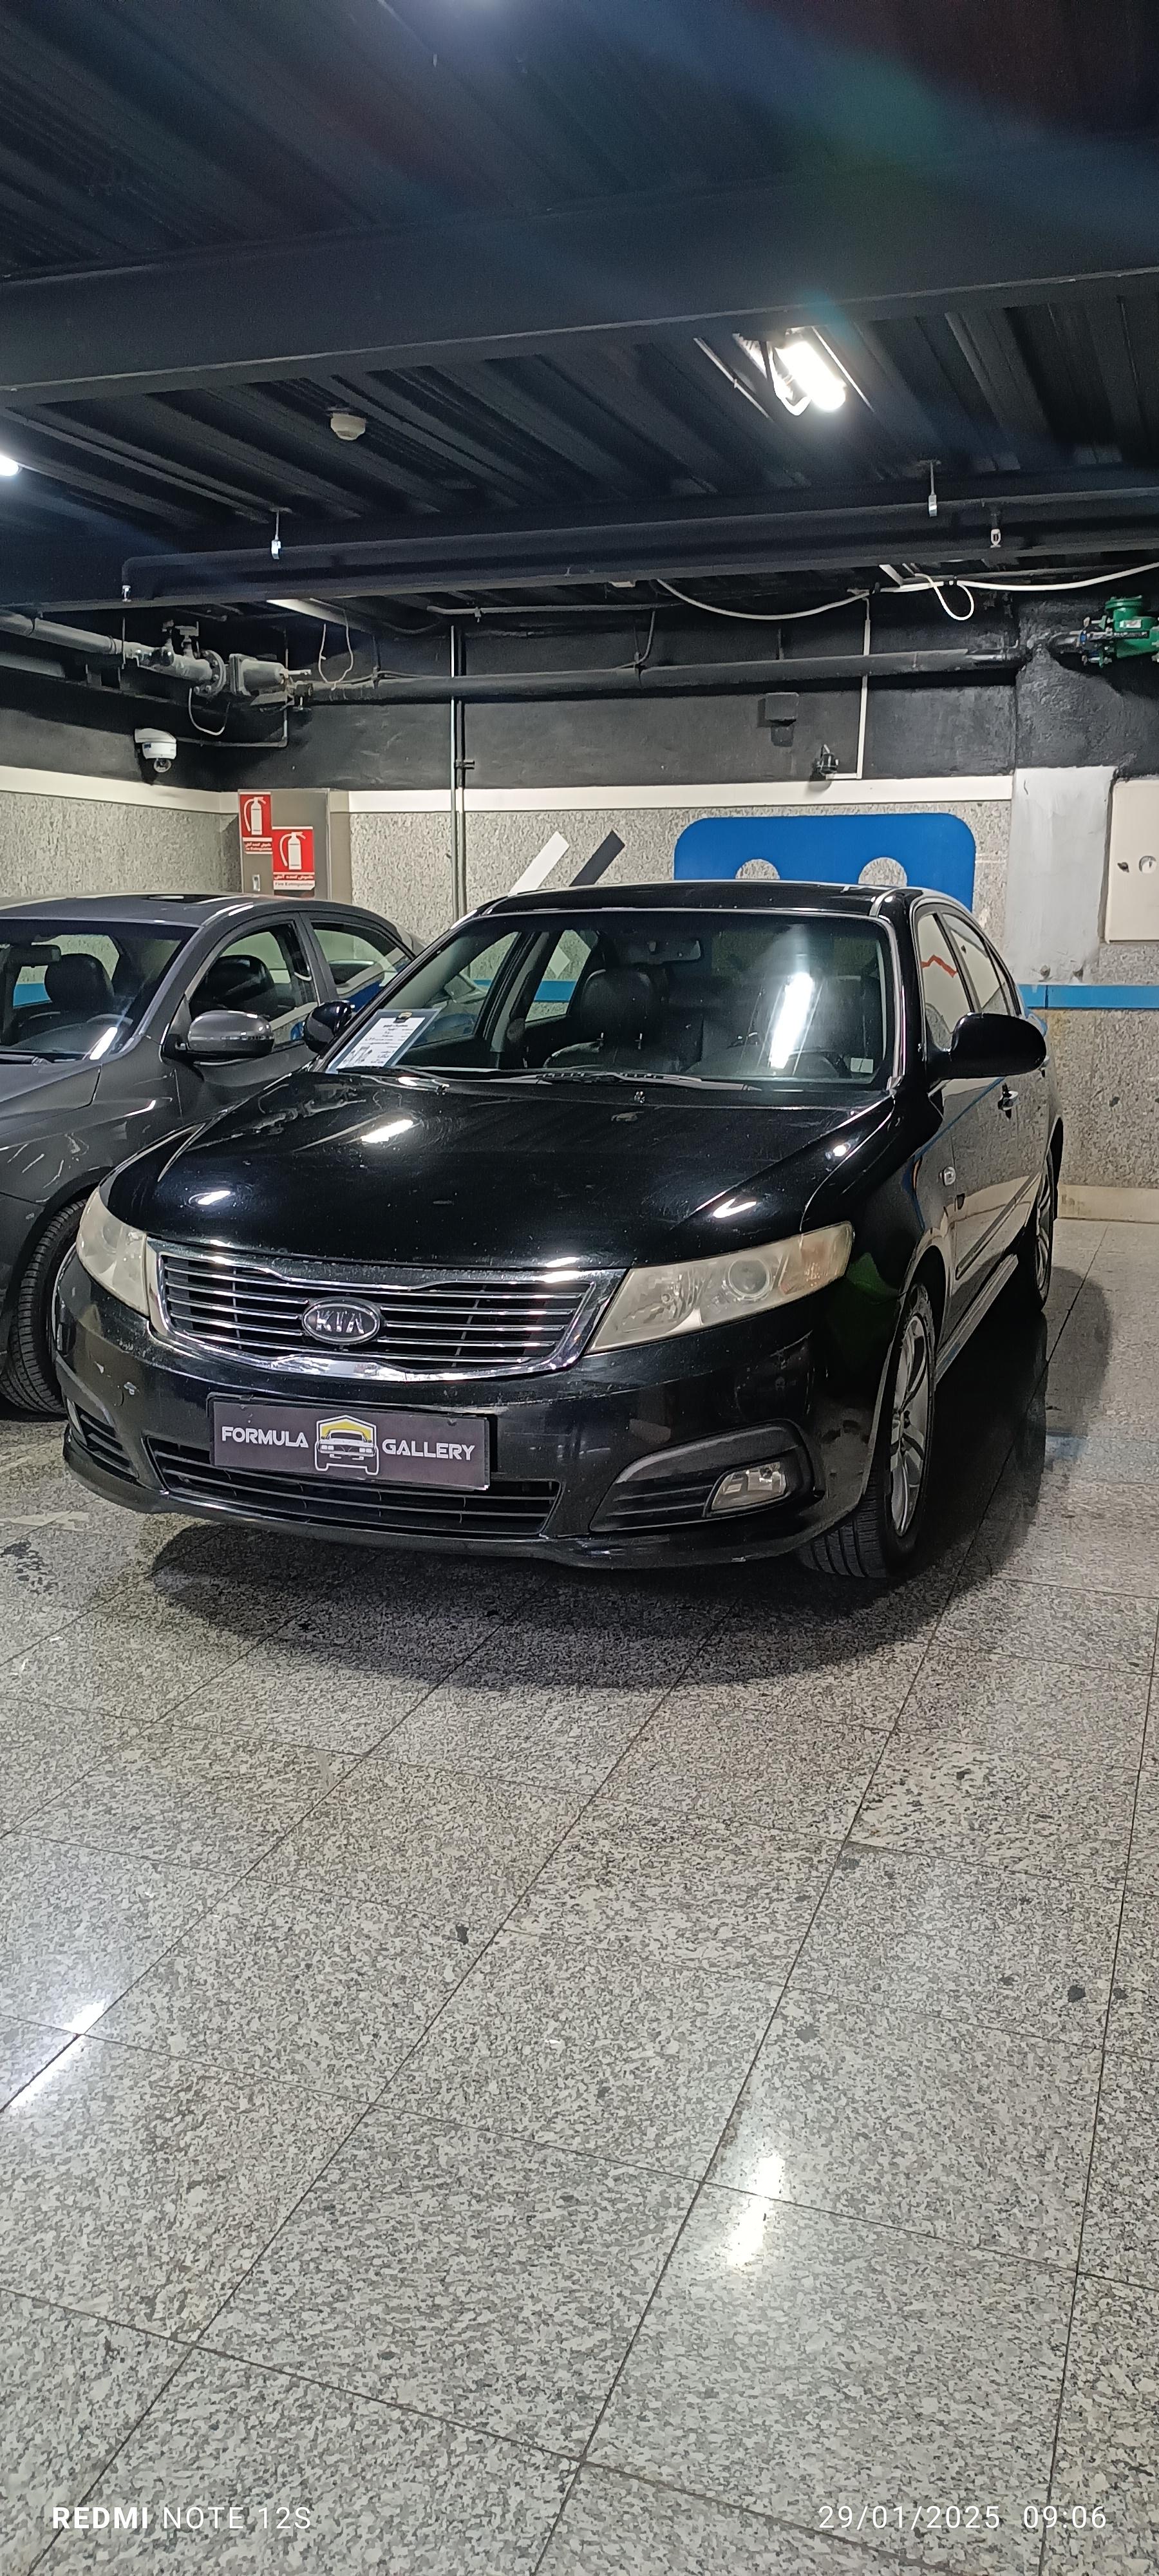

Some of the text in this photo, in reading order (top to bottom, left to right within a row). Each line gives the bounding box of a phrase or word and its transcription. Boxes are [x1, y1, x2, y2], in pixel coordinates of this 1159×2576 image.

[316, 1310, 364, 1334] KIA
[221, 1426, 476, 1461] FORMULA GALLERY
